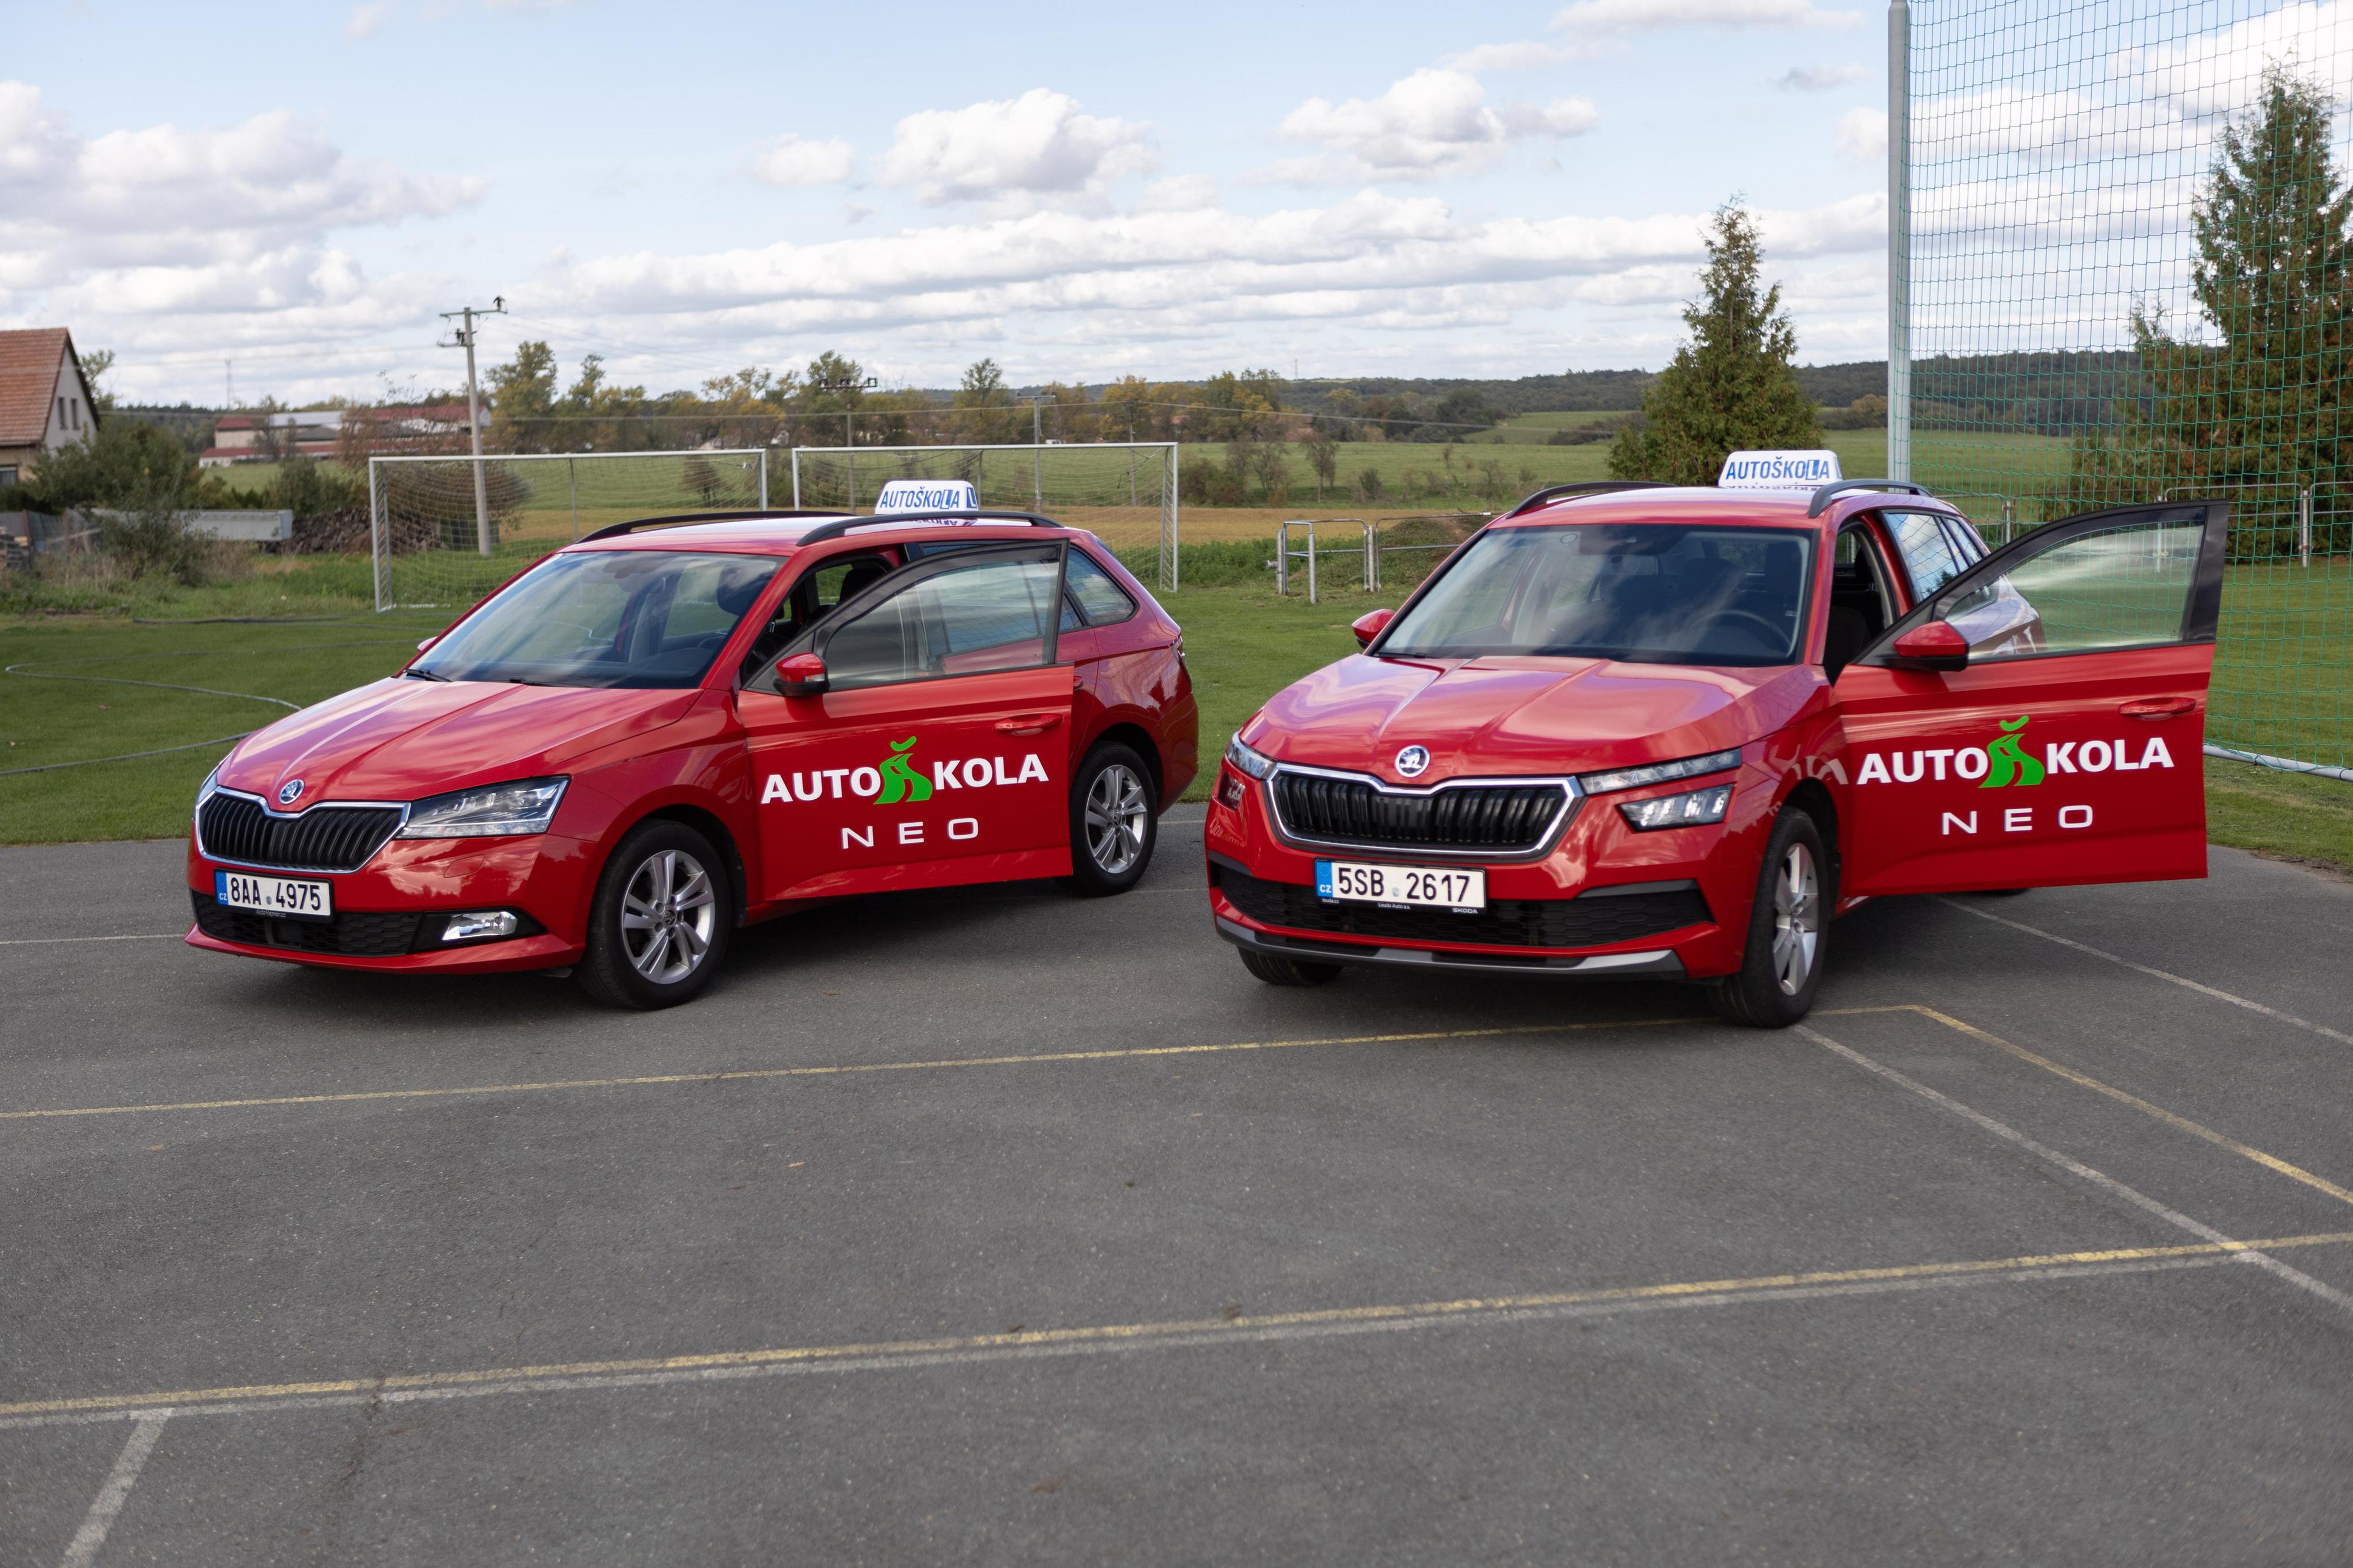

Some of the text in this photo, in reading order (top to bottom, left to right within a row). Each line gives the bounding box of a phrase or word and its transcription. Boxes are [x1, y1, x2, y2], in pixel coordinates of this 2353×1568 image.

[1725, 456, 1830, 481] AUTOŠKOLA
[880, 486, 960, 509] AUTOŠKOLA
[841, 818, 979, 849] NEO
[1942, 805, 2094, 835] NEO
[219, 892, 228, 901] CZ
[230, 877, 321, 911] 8AA 4975
[1319, 884, 1332, 893] CZ
[1338, 867, 1470, 903] 5SB 2617
